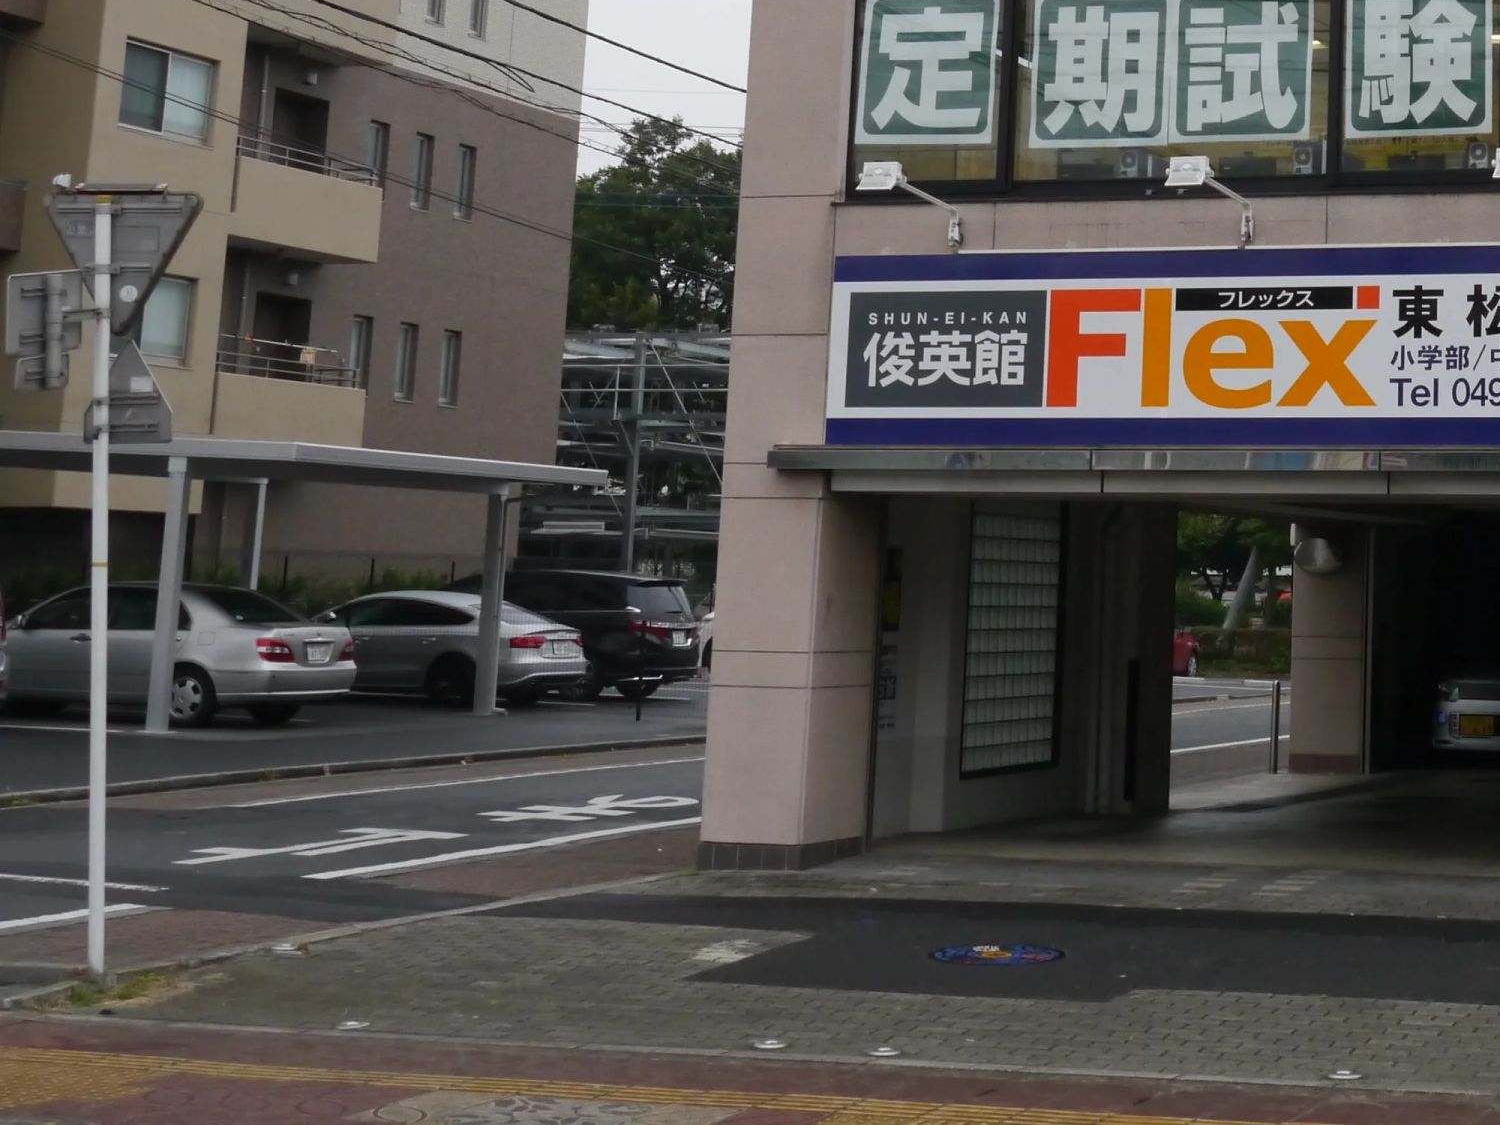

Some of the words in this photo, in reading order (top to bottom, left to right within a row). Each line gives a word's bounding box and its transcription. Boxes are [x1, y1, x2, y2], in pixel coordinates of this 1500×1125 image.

[1218, 289, 1314, 308] フレックス
[868, 311, 1027, 325] SHUN-EI-KAN
[864, 330, 1027, 387] 俊英館
[1046, 287, 1379, 409] Flex
[1390, 378, 1438, 407] Tel
